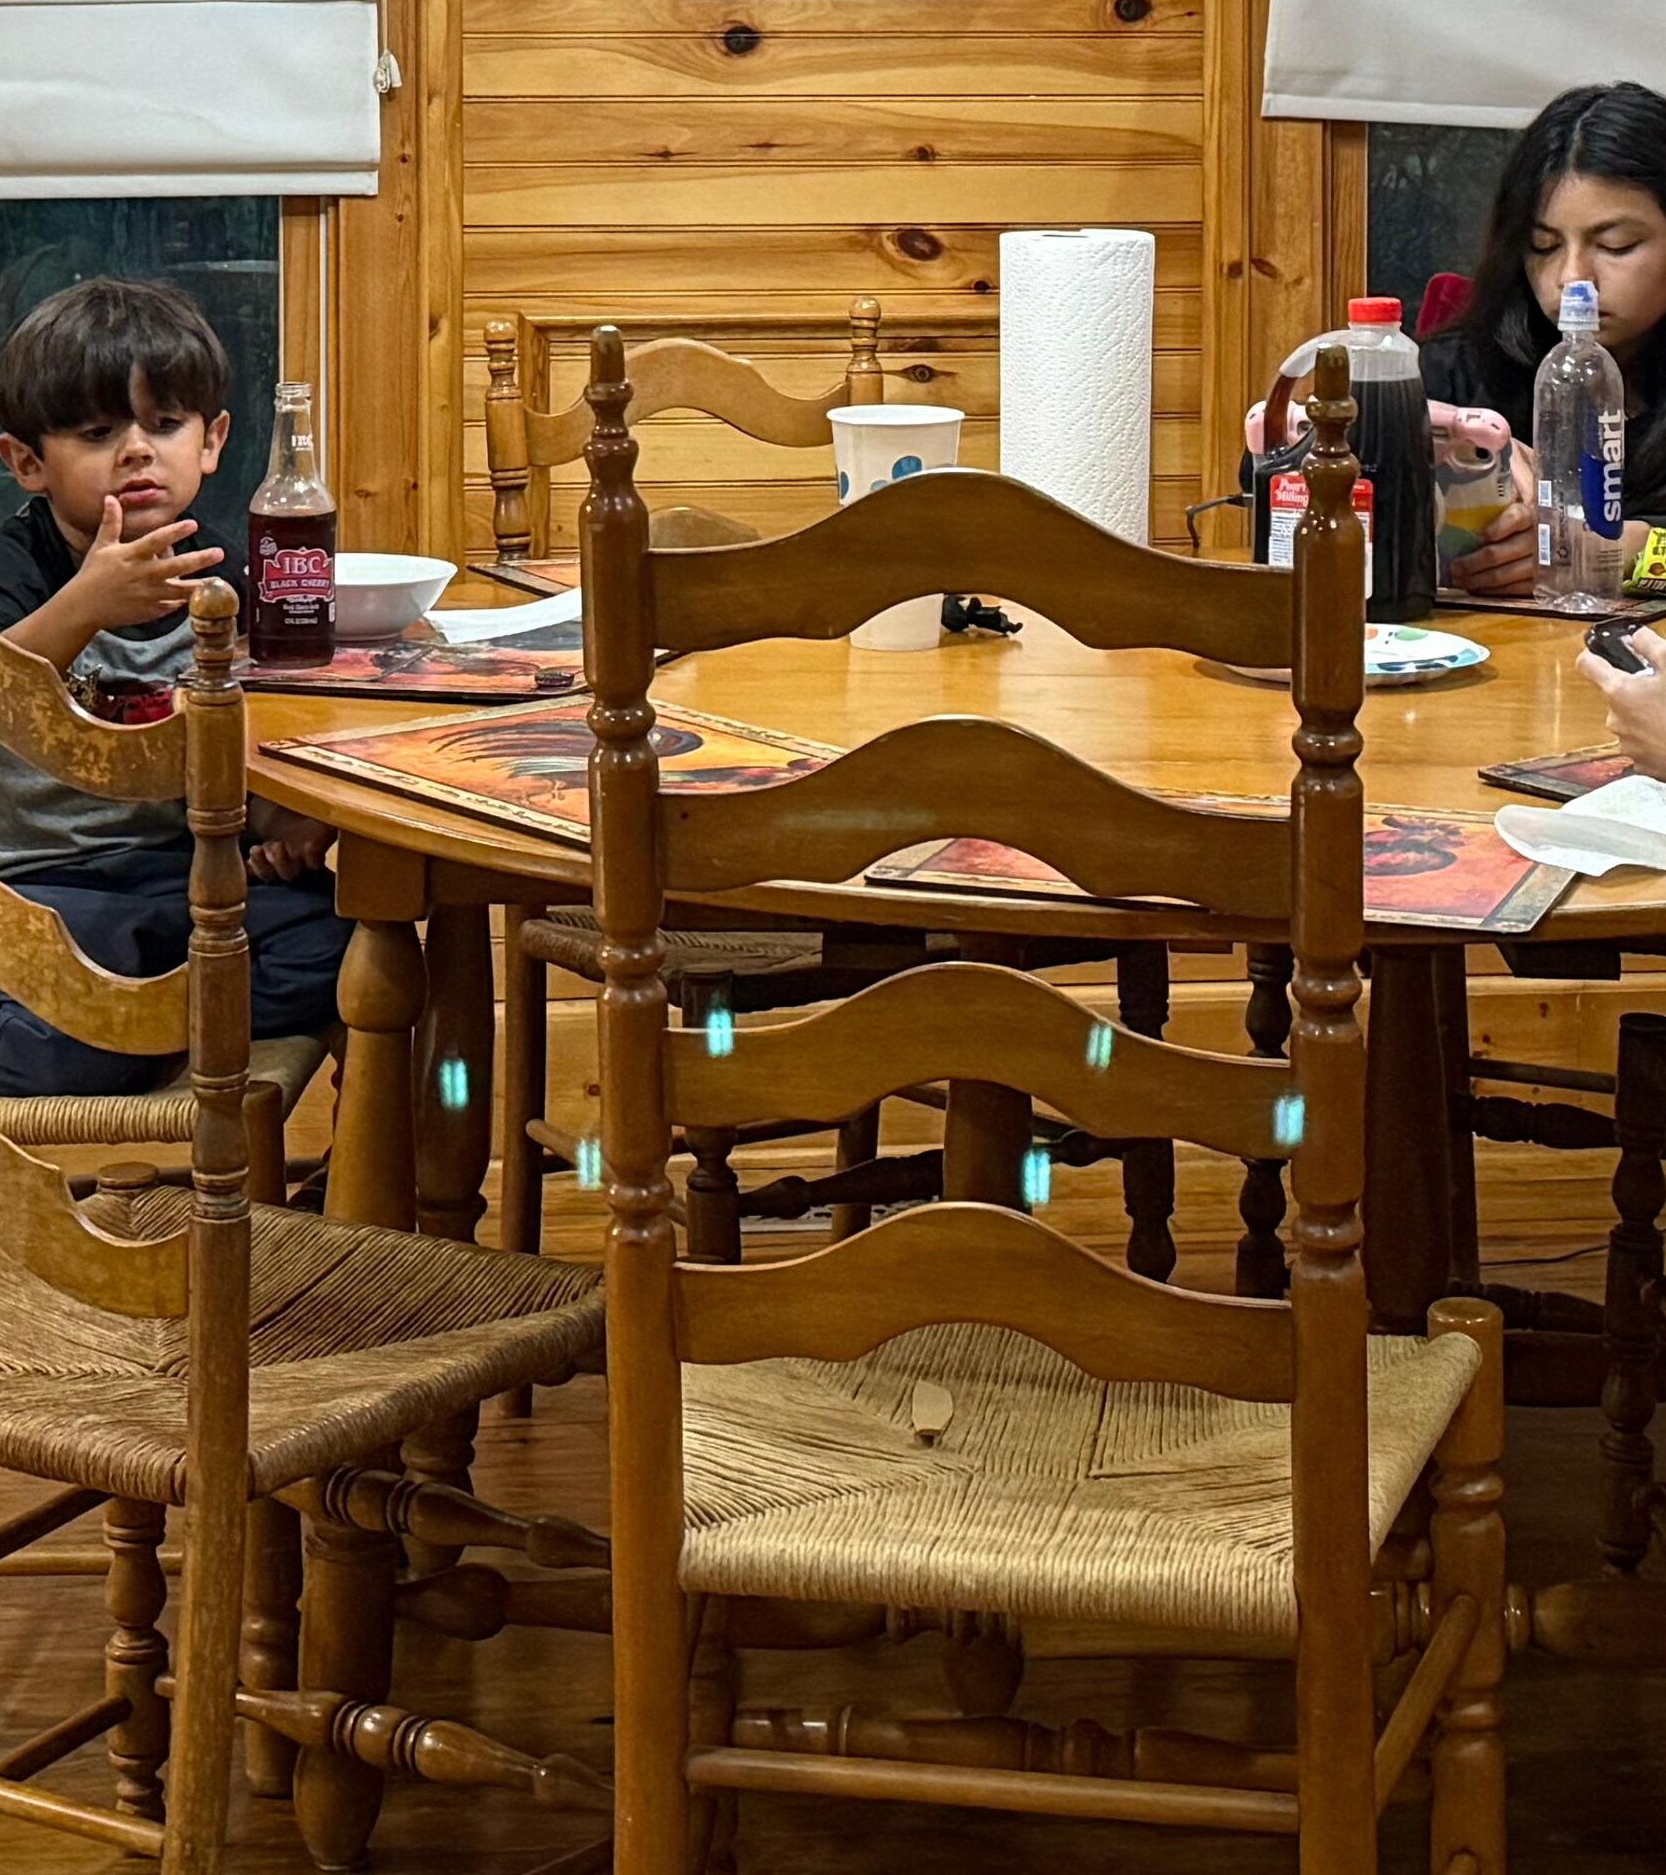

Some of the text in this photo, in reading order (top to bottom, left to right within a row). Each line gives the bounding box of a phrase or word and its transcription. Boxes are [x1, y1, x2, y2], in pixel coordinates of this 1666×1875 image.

[1597, 408, 1622, 523] smart
[1279, 477, 1307, 492] Pear
[283, 556, 322, 574] IBC
[270, 580, 299, 589] BLACK
